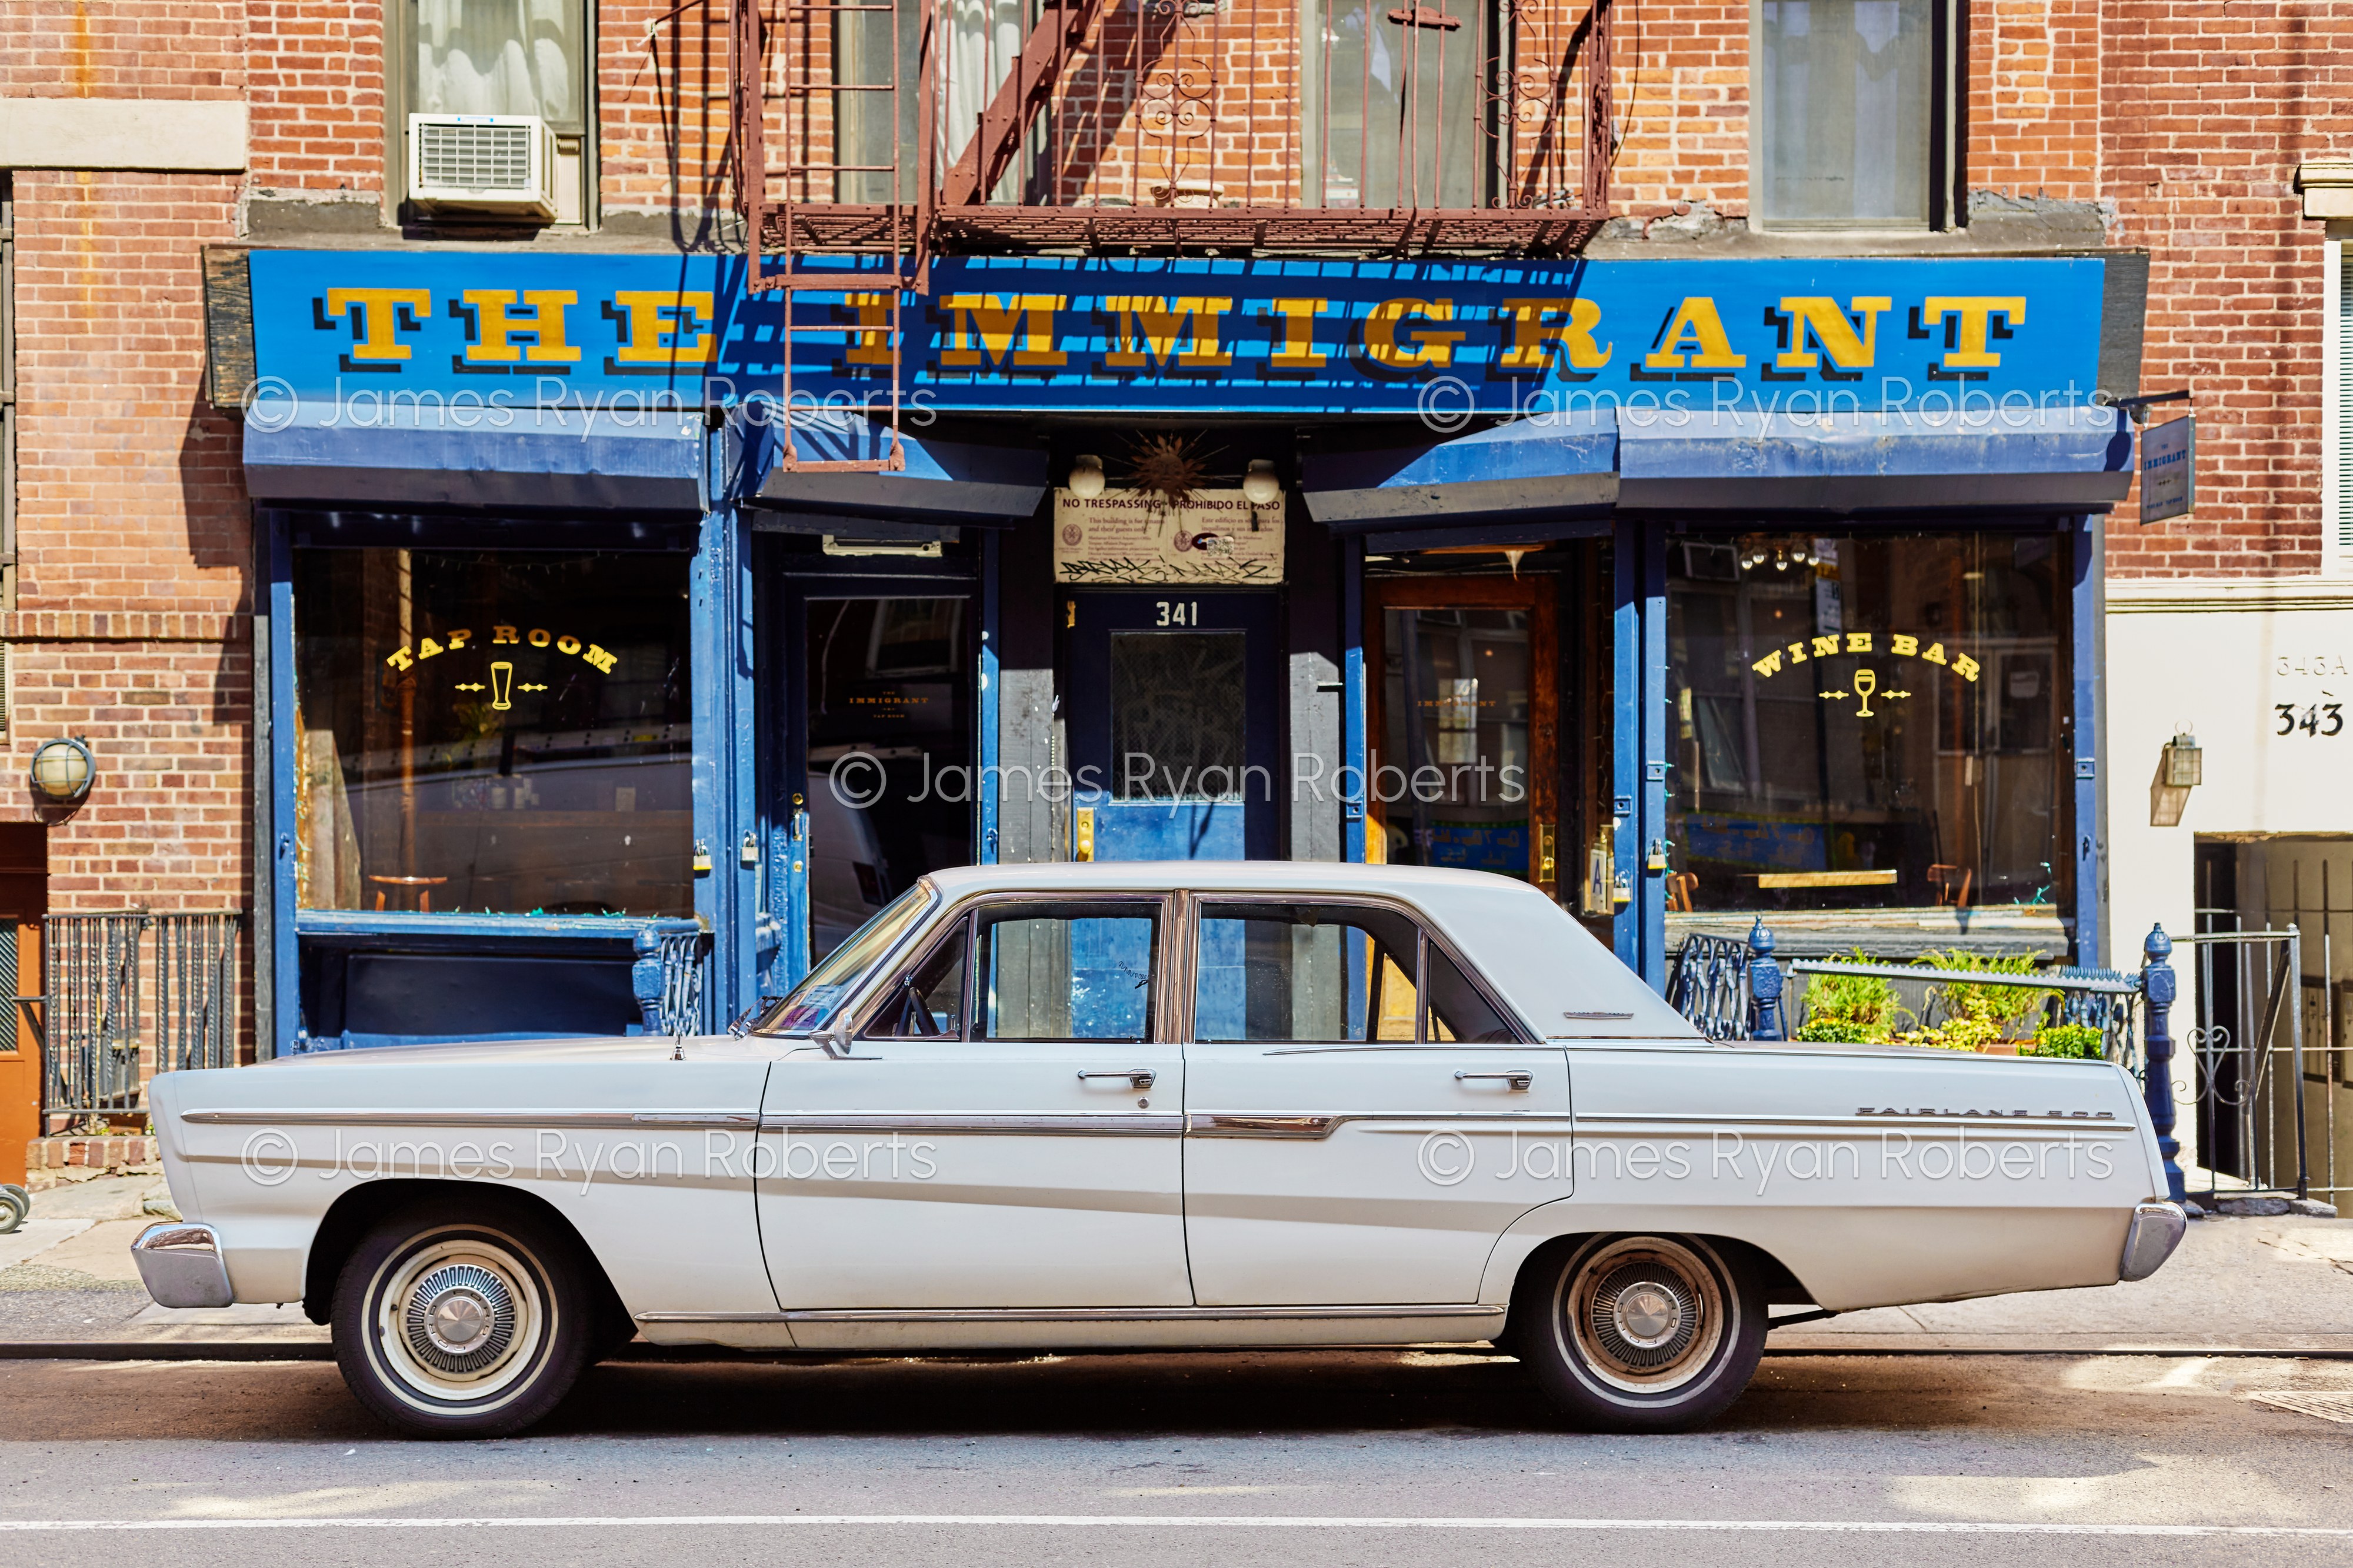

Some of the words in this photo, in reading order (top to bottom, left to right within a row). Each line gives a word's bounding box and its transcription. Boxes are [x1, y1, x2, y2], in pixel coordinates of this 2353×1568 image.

[326, 287, 718, 363] THE
[845, 293, 2027, 369] IMMIGRANT
[2144, 449, 2187, 471] IMMIGRANT
[1062, 498, 1081, 509] NO
[1084, 498, 1162, 509] TRESPASSING
[1174, 500, 1234, 510] PROHIBIDO
[1237, 501, 1249, 510] EL
[1102, 516, 1127, 525] building
[1156, 601, 1198, 626] 341
[386, 628, 472, 672] TAP
[492, 625, 618, 675] ROOM
[1751, 632, 1872, 678] WINE
[1891, 633, 1981, 682] BAR
[2274, 703, 2344, 738] 343
[1592, 858, 1602, 895] A
[1857, 1107, 2028, 1117] FAIRLANE
